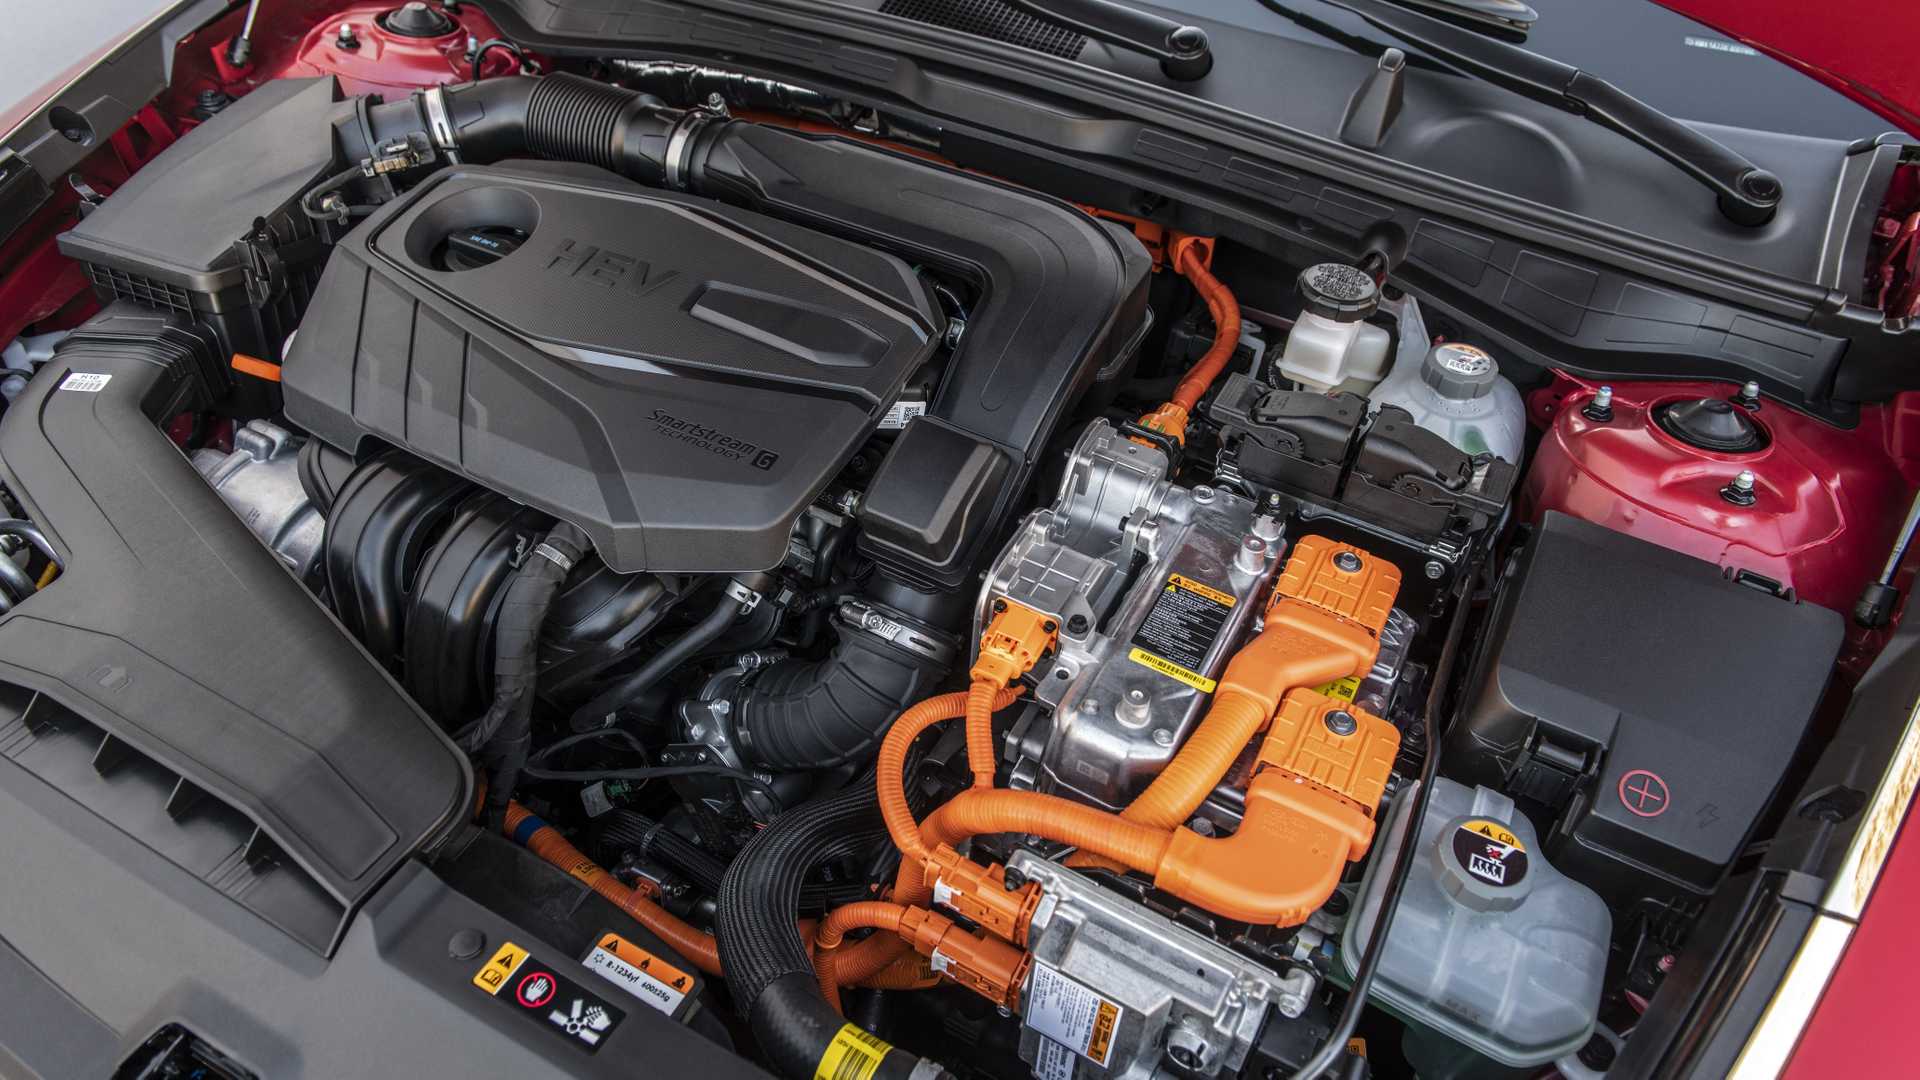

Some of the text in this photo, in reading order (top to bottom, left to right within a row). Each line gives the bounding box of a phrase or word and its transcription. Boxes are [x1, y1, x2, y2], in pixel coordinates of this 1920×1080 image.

[547, 239, 681, 296] HEV
[647, 408, 779, 471] Smartstream G
[655, 424, 745, 462] TECHNOLOGY
[606, 961, 640, 983] R-1234yf
